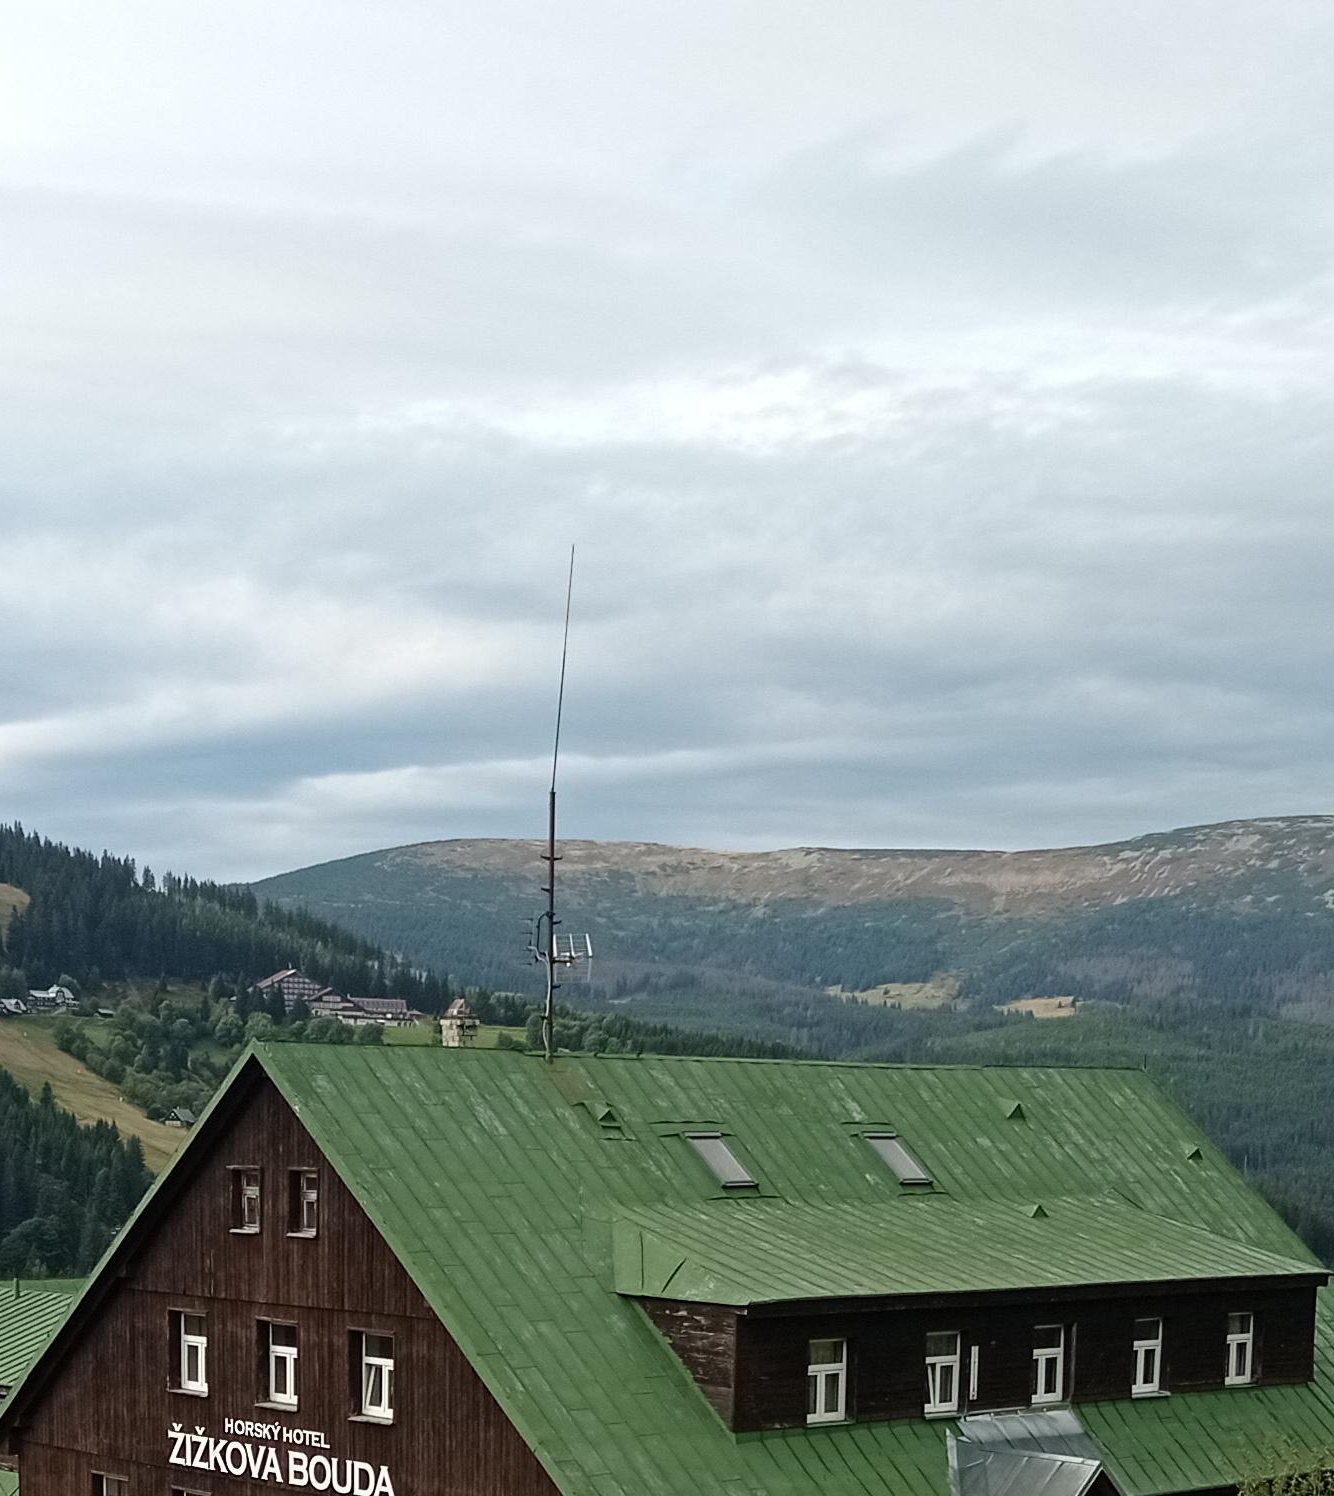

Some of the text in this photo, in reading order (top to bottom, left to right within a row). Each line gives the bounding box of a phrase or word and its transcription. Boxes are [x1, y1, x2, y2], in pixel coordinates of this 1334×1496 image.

[168, 1422, 283, 1483] ŽIŽKOVA
[224, 1417, 330, 1449] HORSKÝ HOTEL
